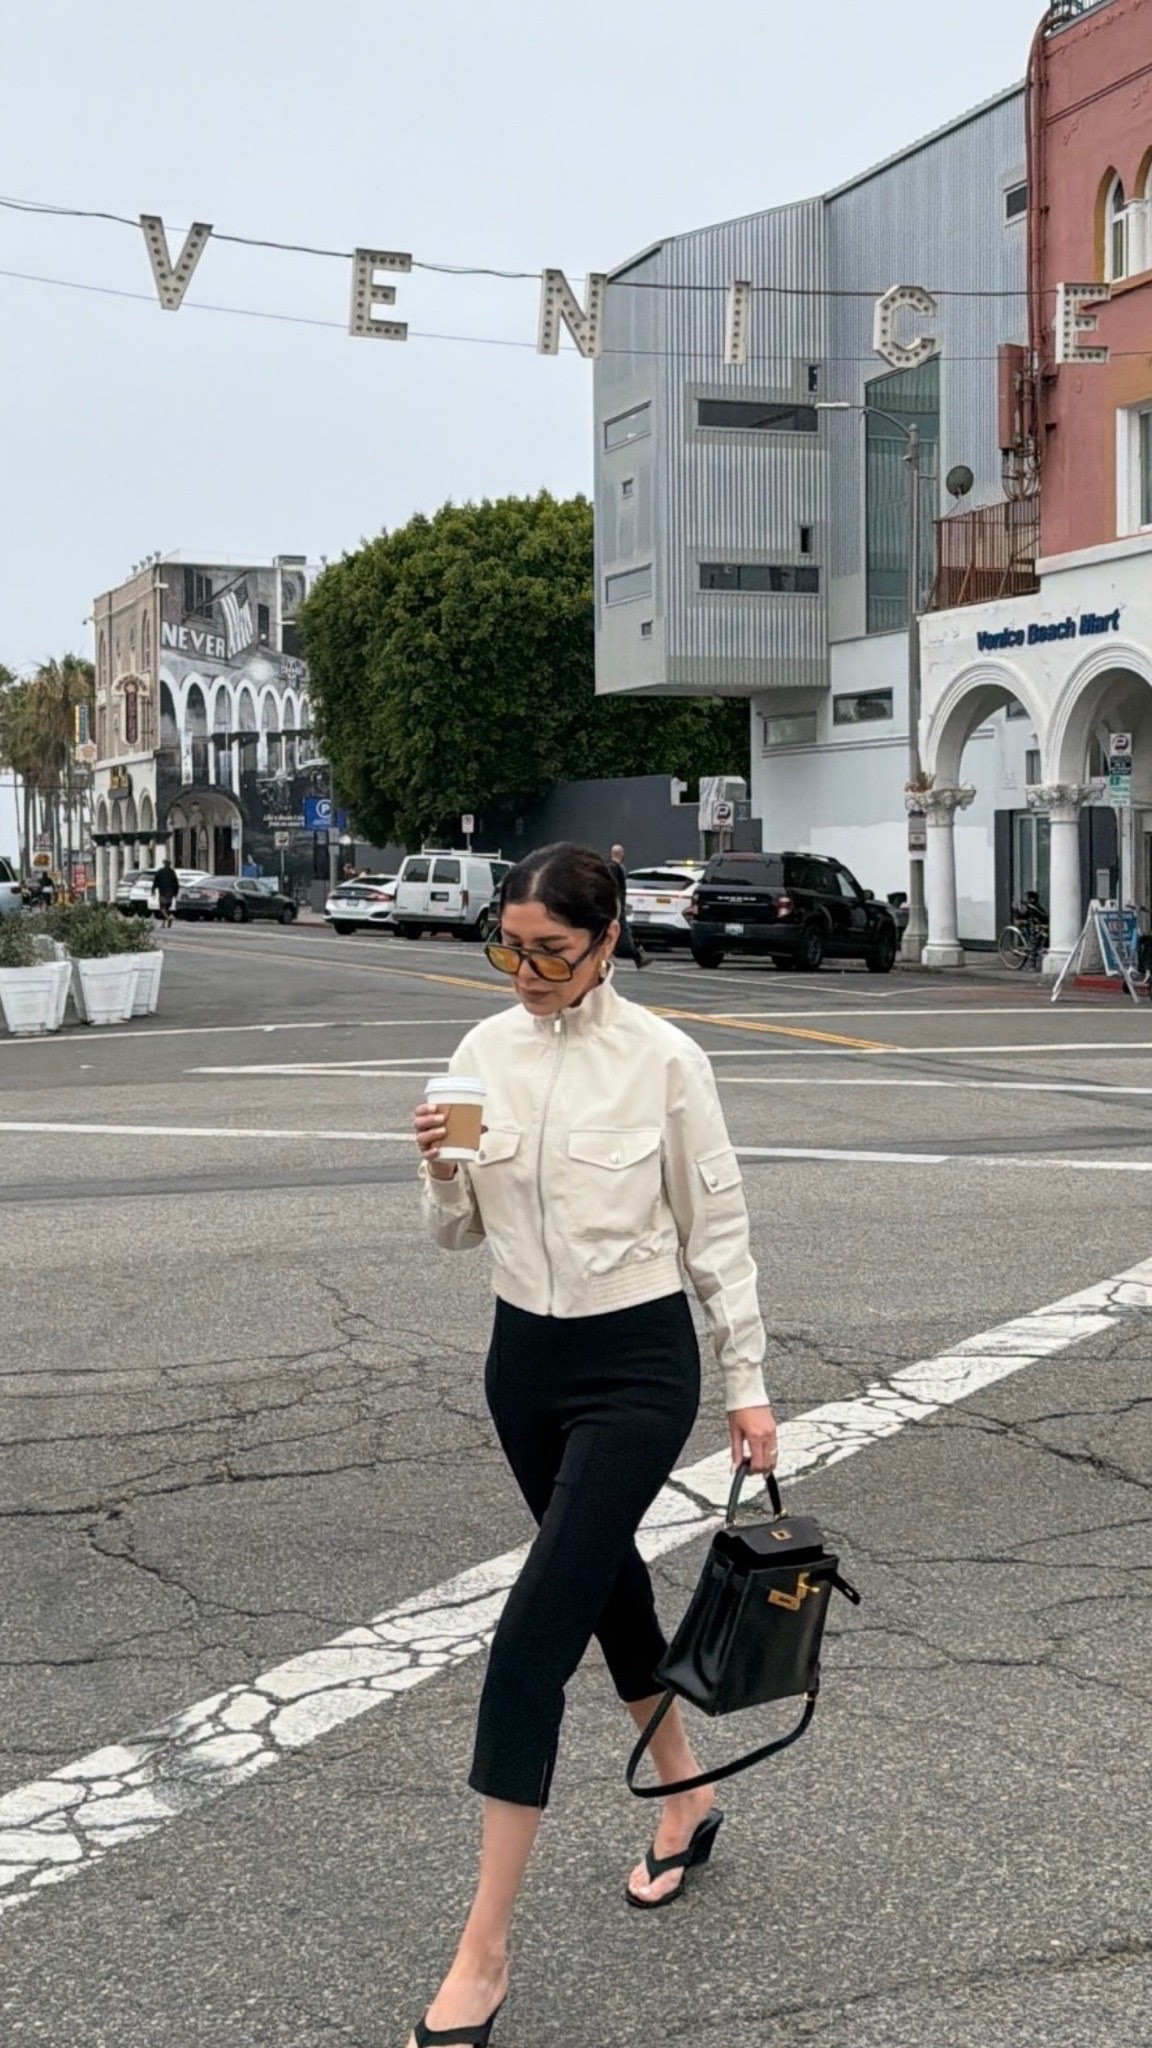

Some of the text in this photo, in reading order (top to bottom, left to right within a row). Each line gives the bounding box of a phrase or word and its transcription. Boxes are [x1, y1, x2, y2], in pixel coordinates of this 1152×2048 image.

[140, 214, 1111, 368] VENICE
[161, 621, 225, 659] NEVER
[977, 608, 1120, 651] Venice Beach Mart
